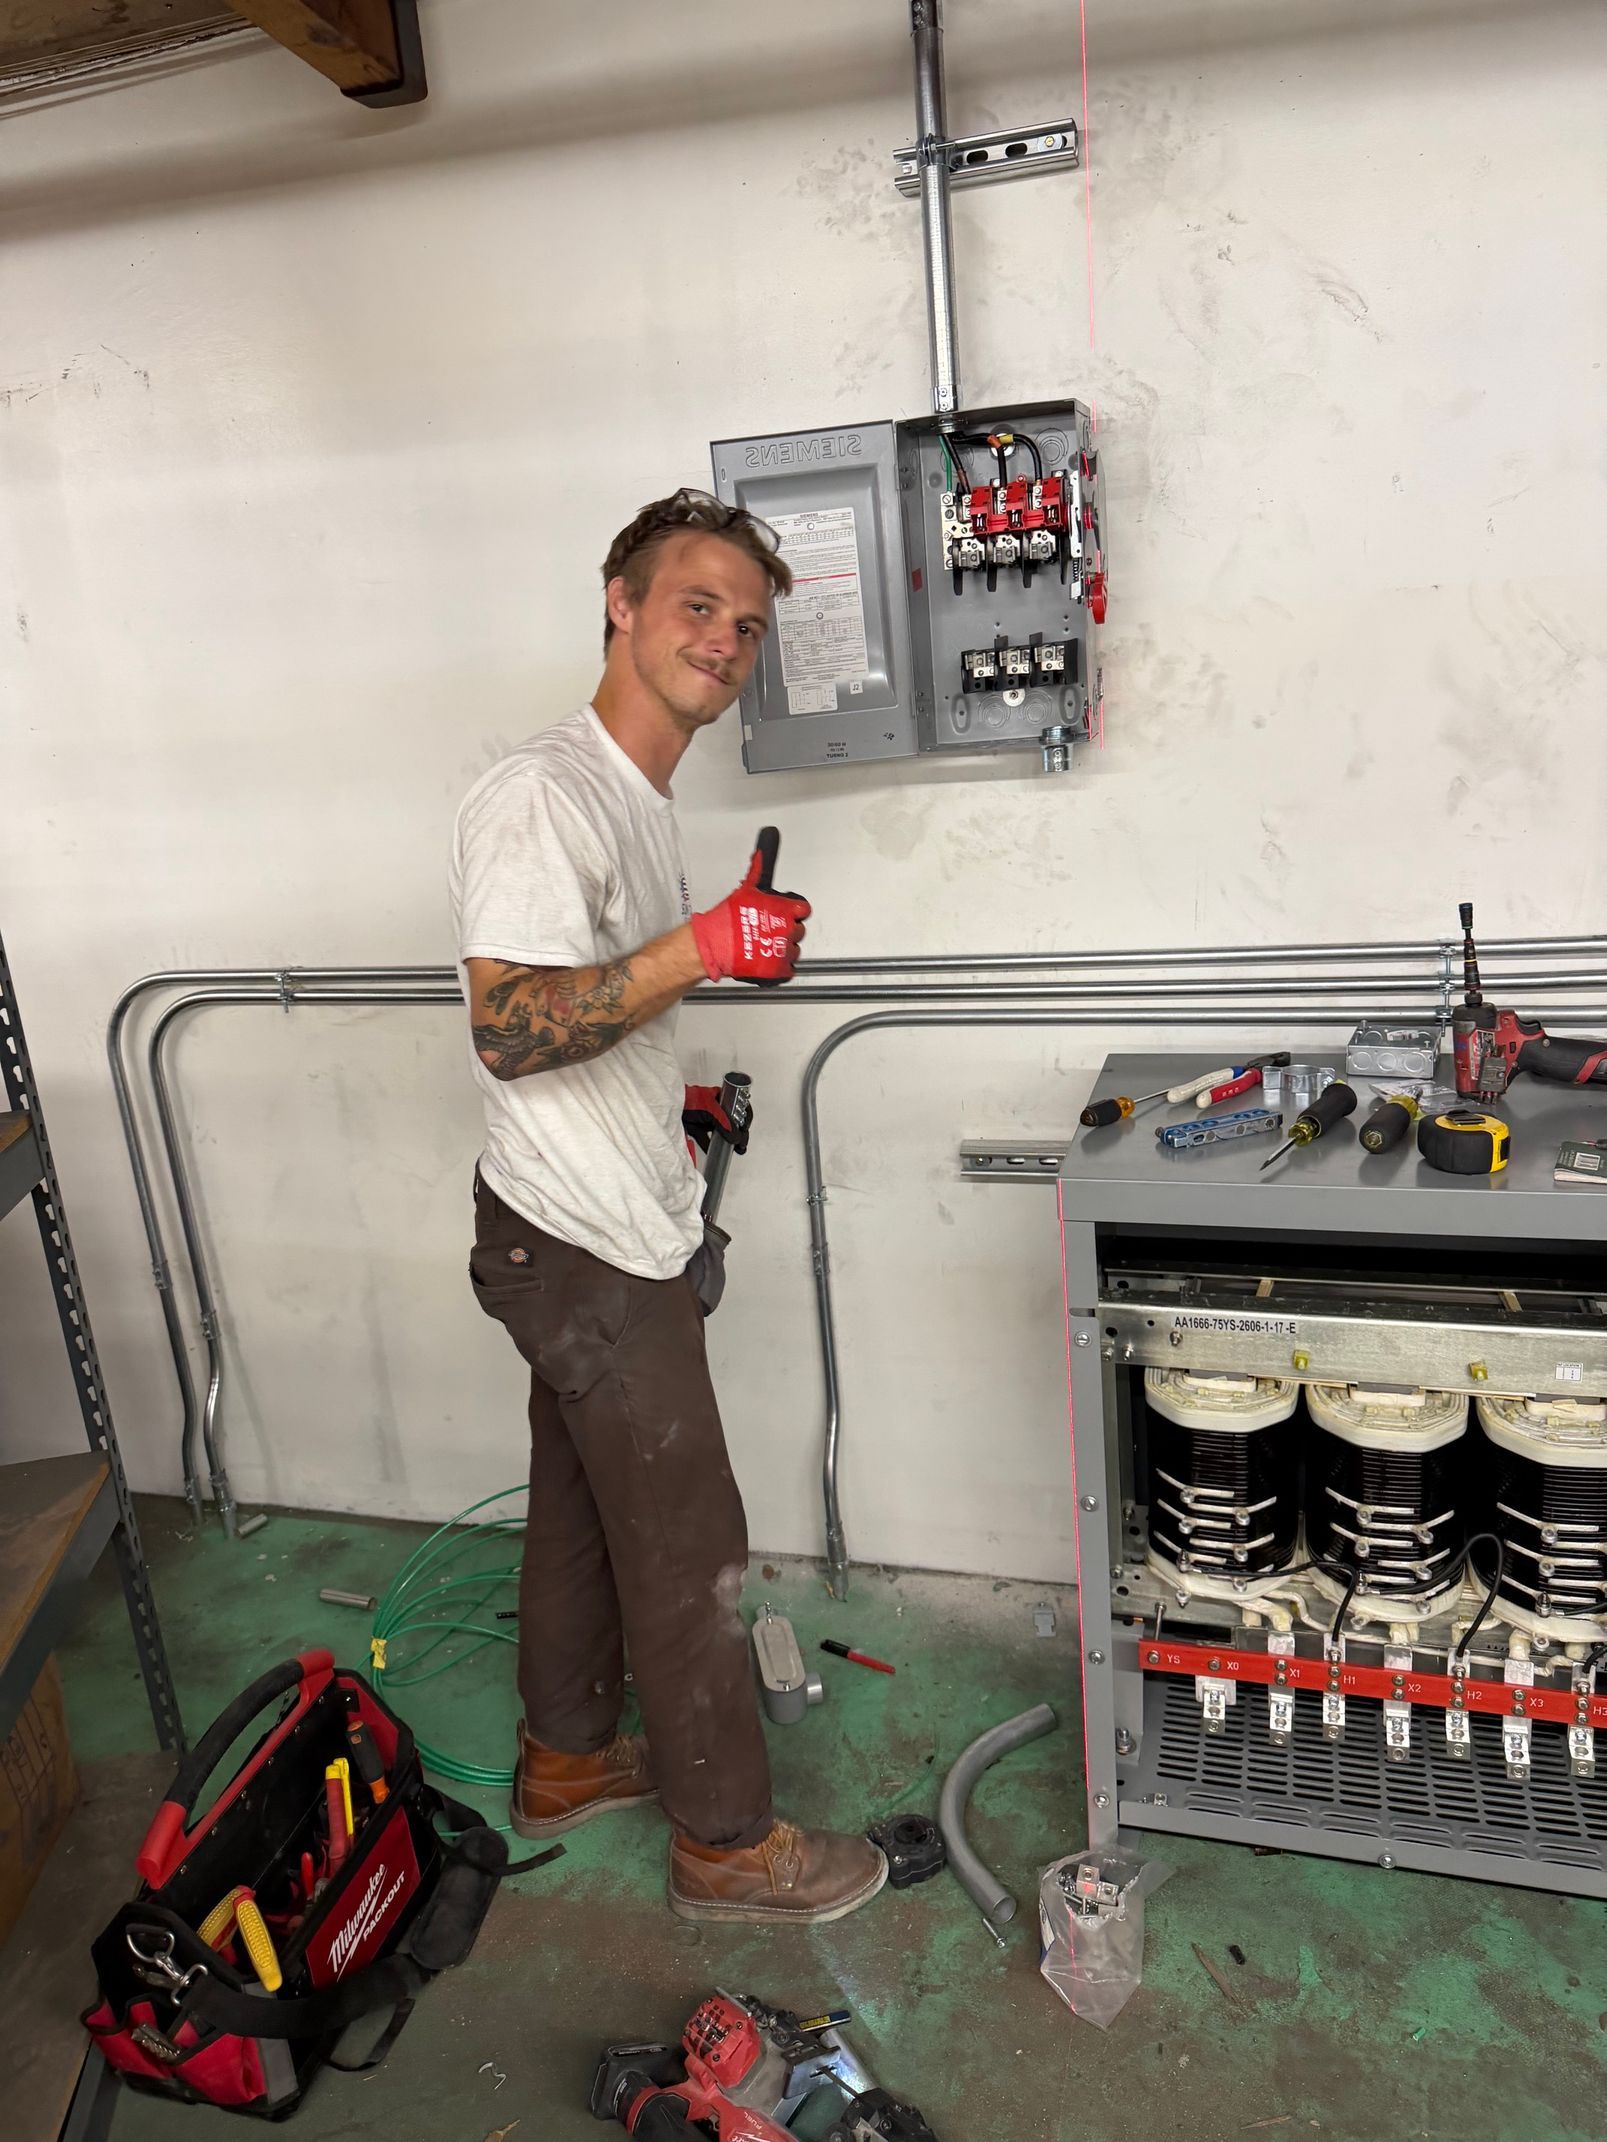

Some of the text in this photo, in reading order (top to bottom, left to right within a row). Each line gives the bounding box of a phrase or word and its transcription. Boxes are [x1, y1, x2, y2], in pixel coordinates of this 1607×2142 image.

[1167, 1654, 1181, 1664] YS
[1289, 1668, 1300, 1678] X1
[1343, 1675, 1356, 1685] H1
[1408, 1684, 1421, 1693] X2
[1467, 1691, 1482, 1700] H2
[1529, 1698, 1544, 1708] X3
[363, 1870, 405, 1942] PACKOUT
[326, 1863, 386, 1973] Milwaukee
[743, 2111, 763, 2130] FUEL
